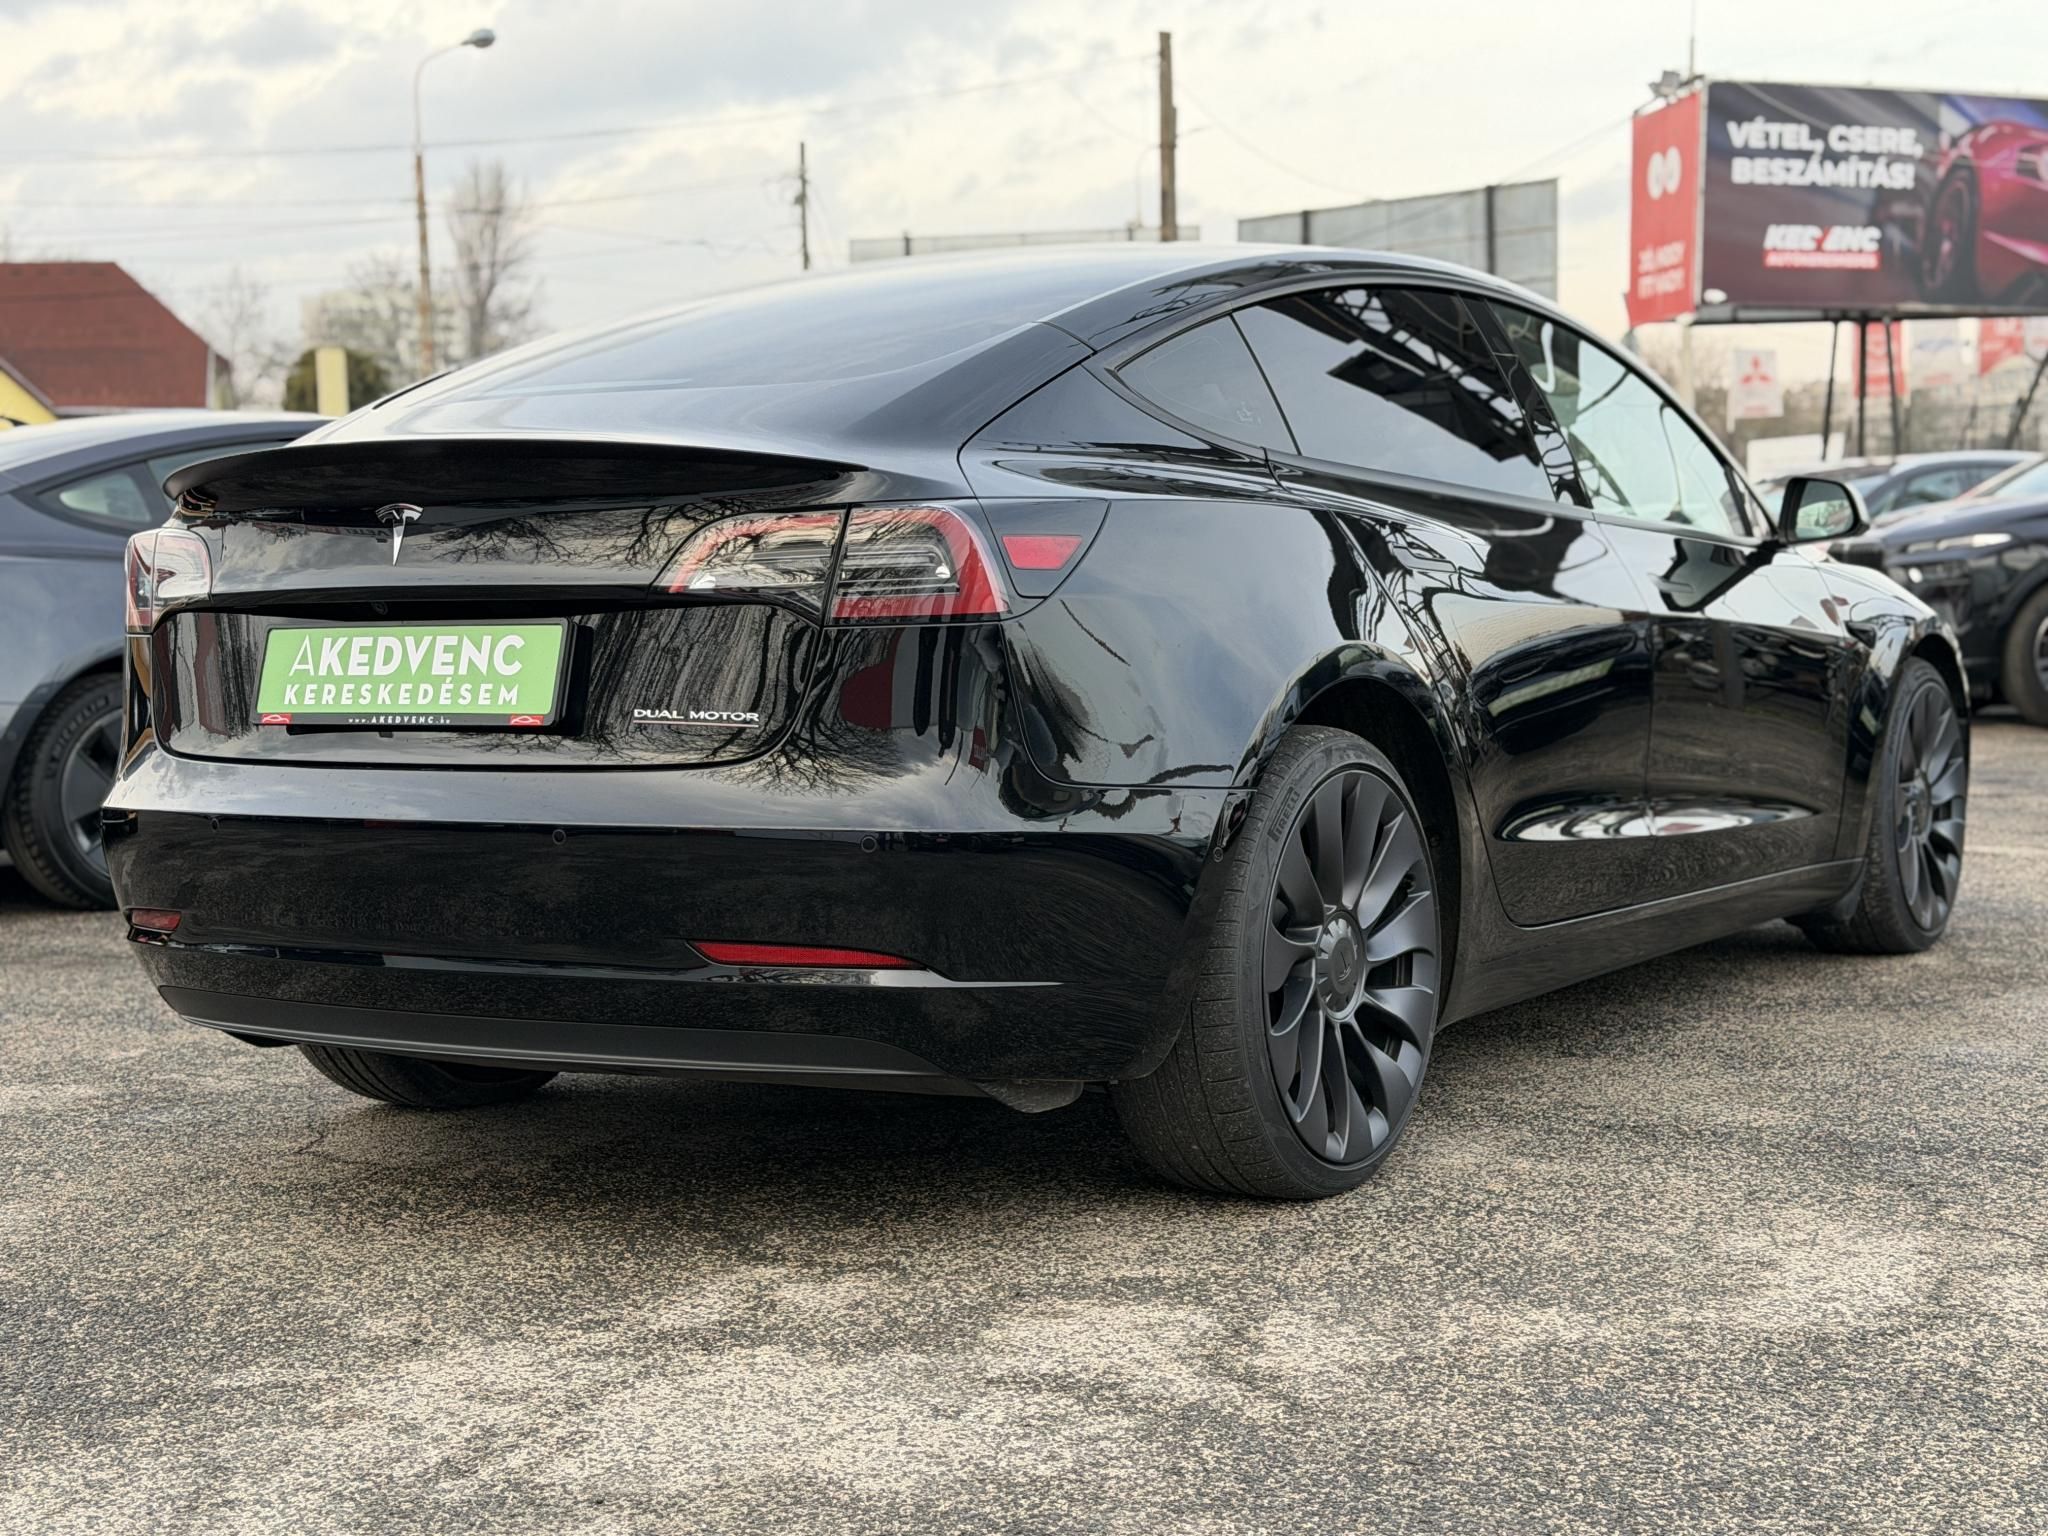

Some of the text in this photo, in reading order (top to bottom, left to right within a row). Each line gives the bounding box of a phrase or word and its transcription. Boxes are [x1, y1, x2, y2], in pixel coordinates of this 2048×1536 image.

[1726, 116, 1924, 159] VÉTEL, CSERE,
[1731, 153, 1915, 190] BESZÁMÍTÁS!
[288, 633, 526, 677] AKEDVENC
[283, 677, 519, 705] KERESKEDÉSEM
[633, 708, 760, 722] DUAL MOTOR
[1267, 786, 1301, 842] PIRELLI
